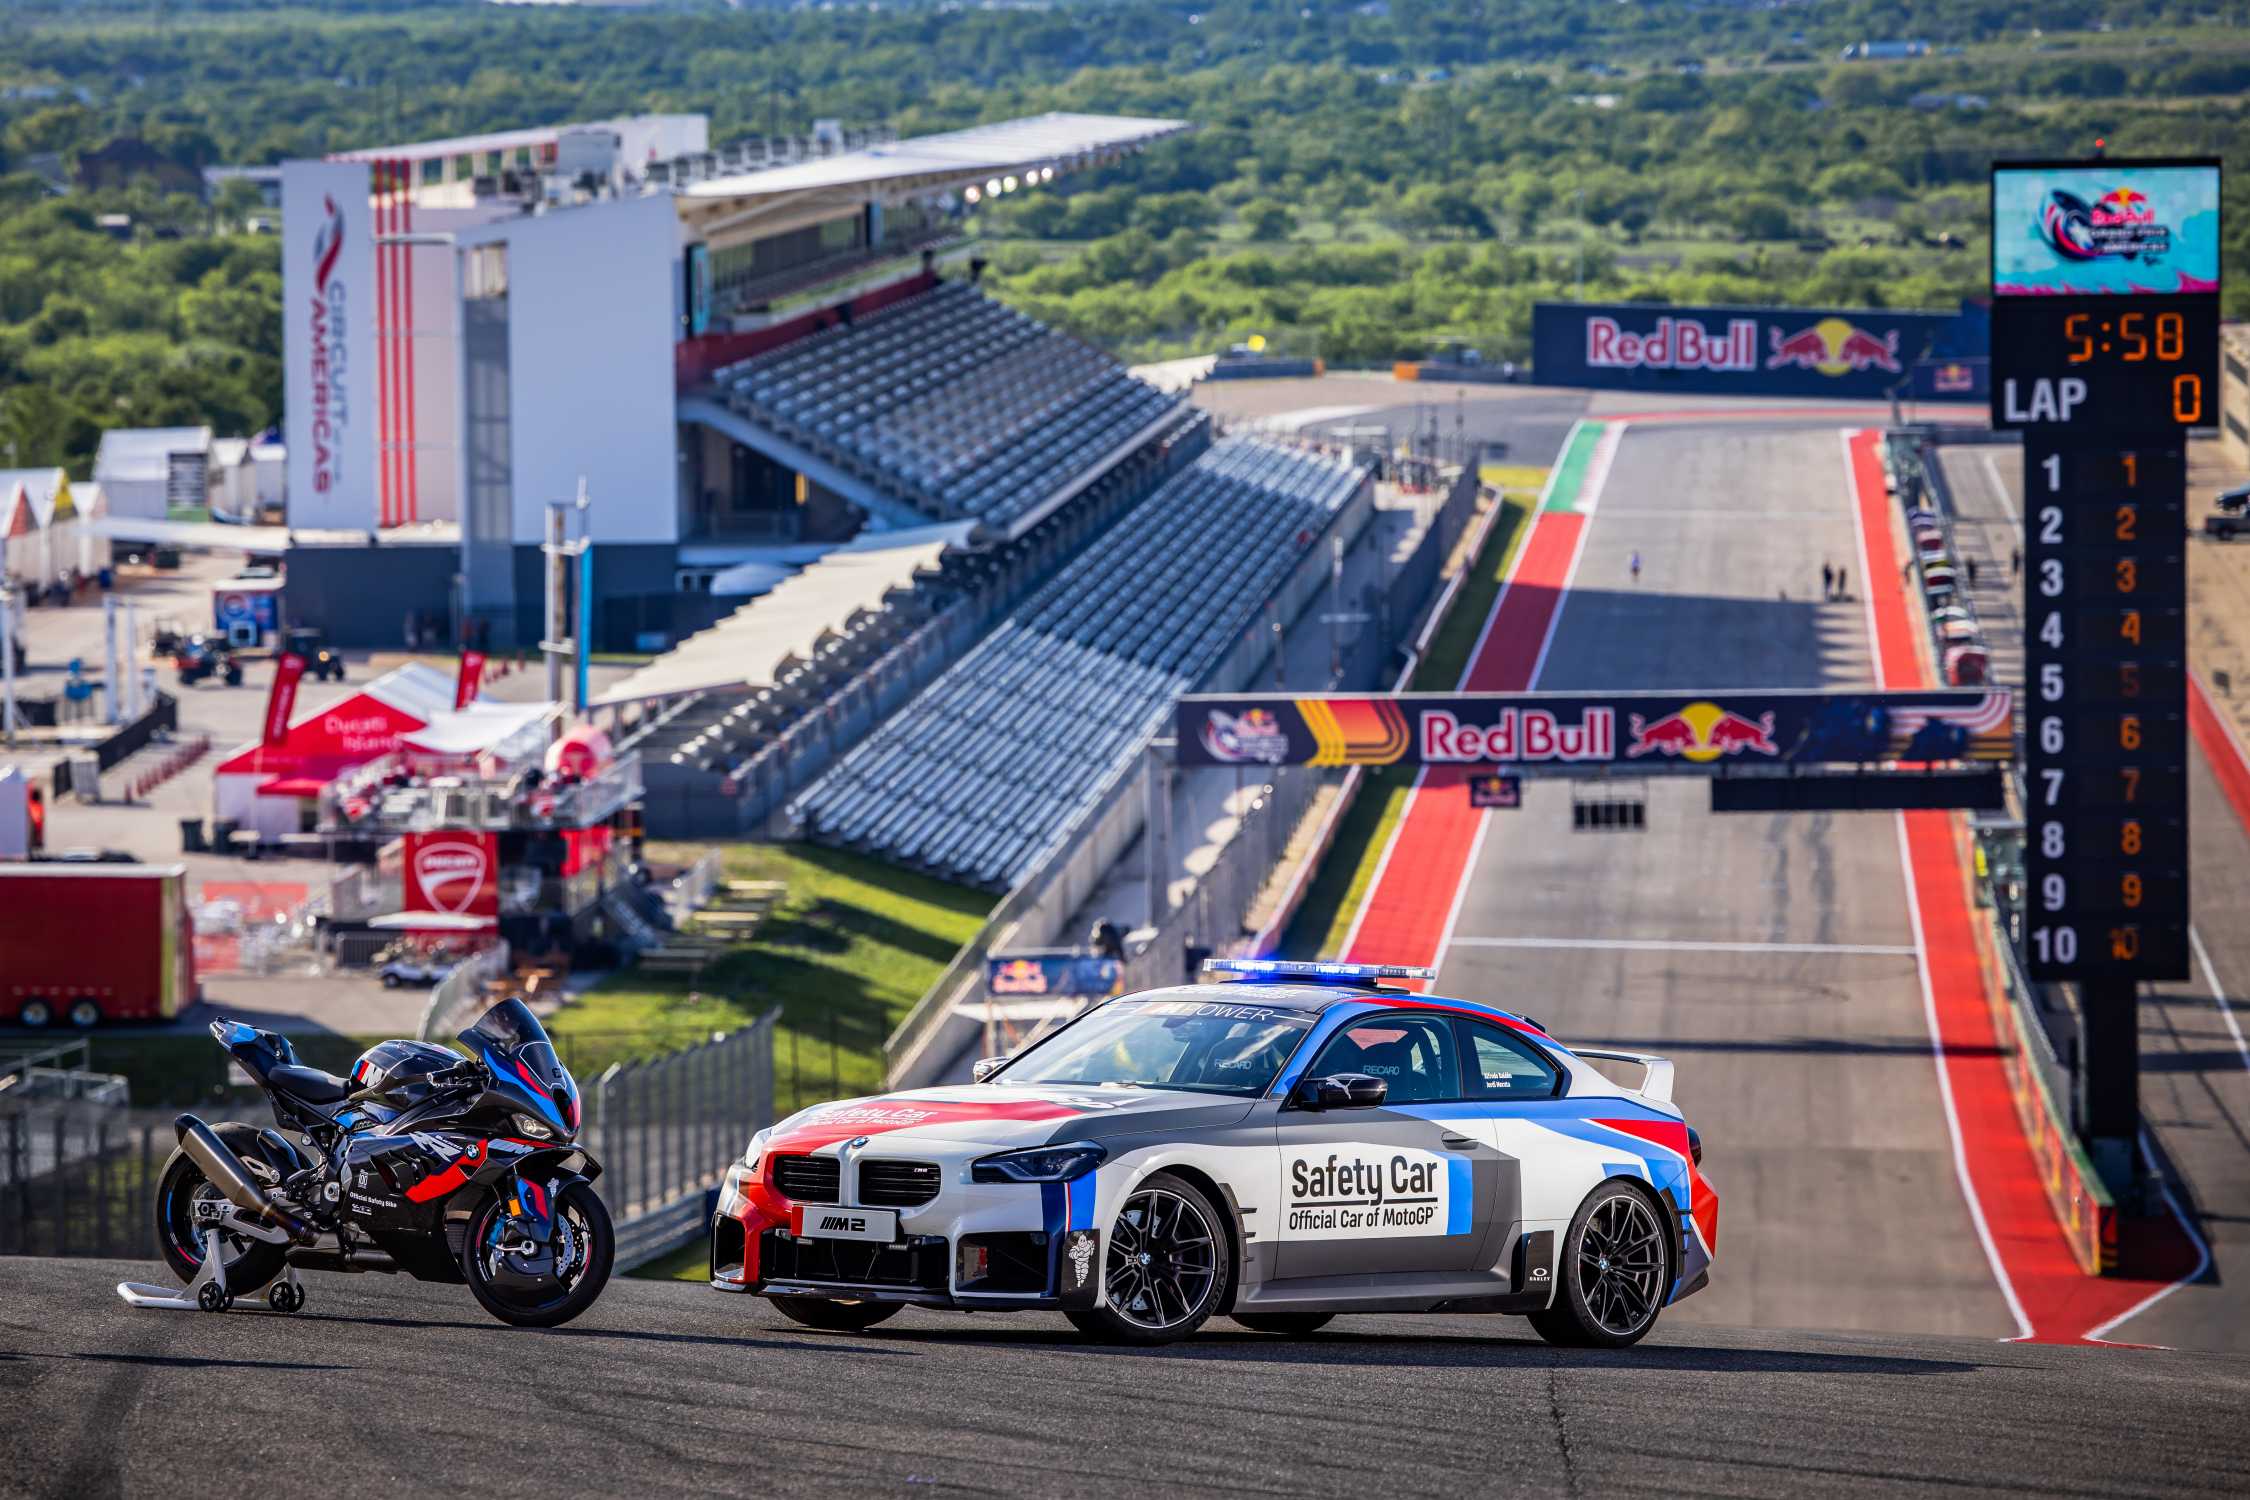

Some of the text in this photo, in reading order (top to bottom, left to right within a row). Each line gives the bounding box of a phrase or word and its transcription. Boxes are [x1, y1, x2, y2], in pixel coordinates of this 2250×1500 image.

[329, 280, 348, 427] CIRCUIT
[1586, 316, 1758, 372] Red Bull
[2065, 313, 2183, 361] 5:58
[310, 297, 333, 493] AMERICAS
[2005, 378, 2087, 421] LAP
[2173, 374, 2201, 422] 0
[2041, 454, 2060, 491] 1
[2120, 455, 2137, 485] 1
[2040, 507, 2062, 543] 2
[2116, 507, 2135, 540] 2
[2040, 559, 2063, 596] 3
[2116, 560, 2136, 592] 3
[2041, 612, 2063, 648] 4
[2121, 612, 2140, 644] 4
[2041, 664, 2063, 701] 5
[1420, 707, 1615, 762] Red Bull
[2041, 716, 2063, 753] 6
[2120, 717, 2141, 750] 6
[2042, 769, 2063, 805] 7
[2042, 822, 2064, 858] 8
[2121, 822, 2142, 855] 8
[2043, 874, 2065, 910] 9
[2121, 874, 2142, 907] 9
[2034, 927, 2076, 963] 10
[1363, 1064, 1400, 1076] RECARO
[1292, 1154, 1437, 1206] Safety Car
[1289, 1207, 1434, 1230] Official Car of MotoGP
